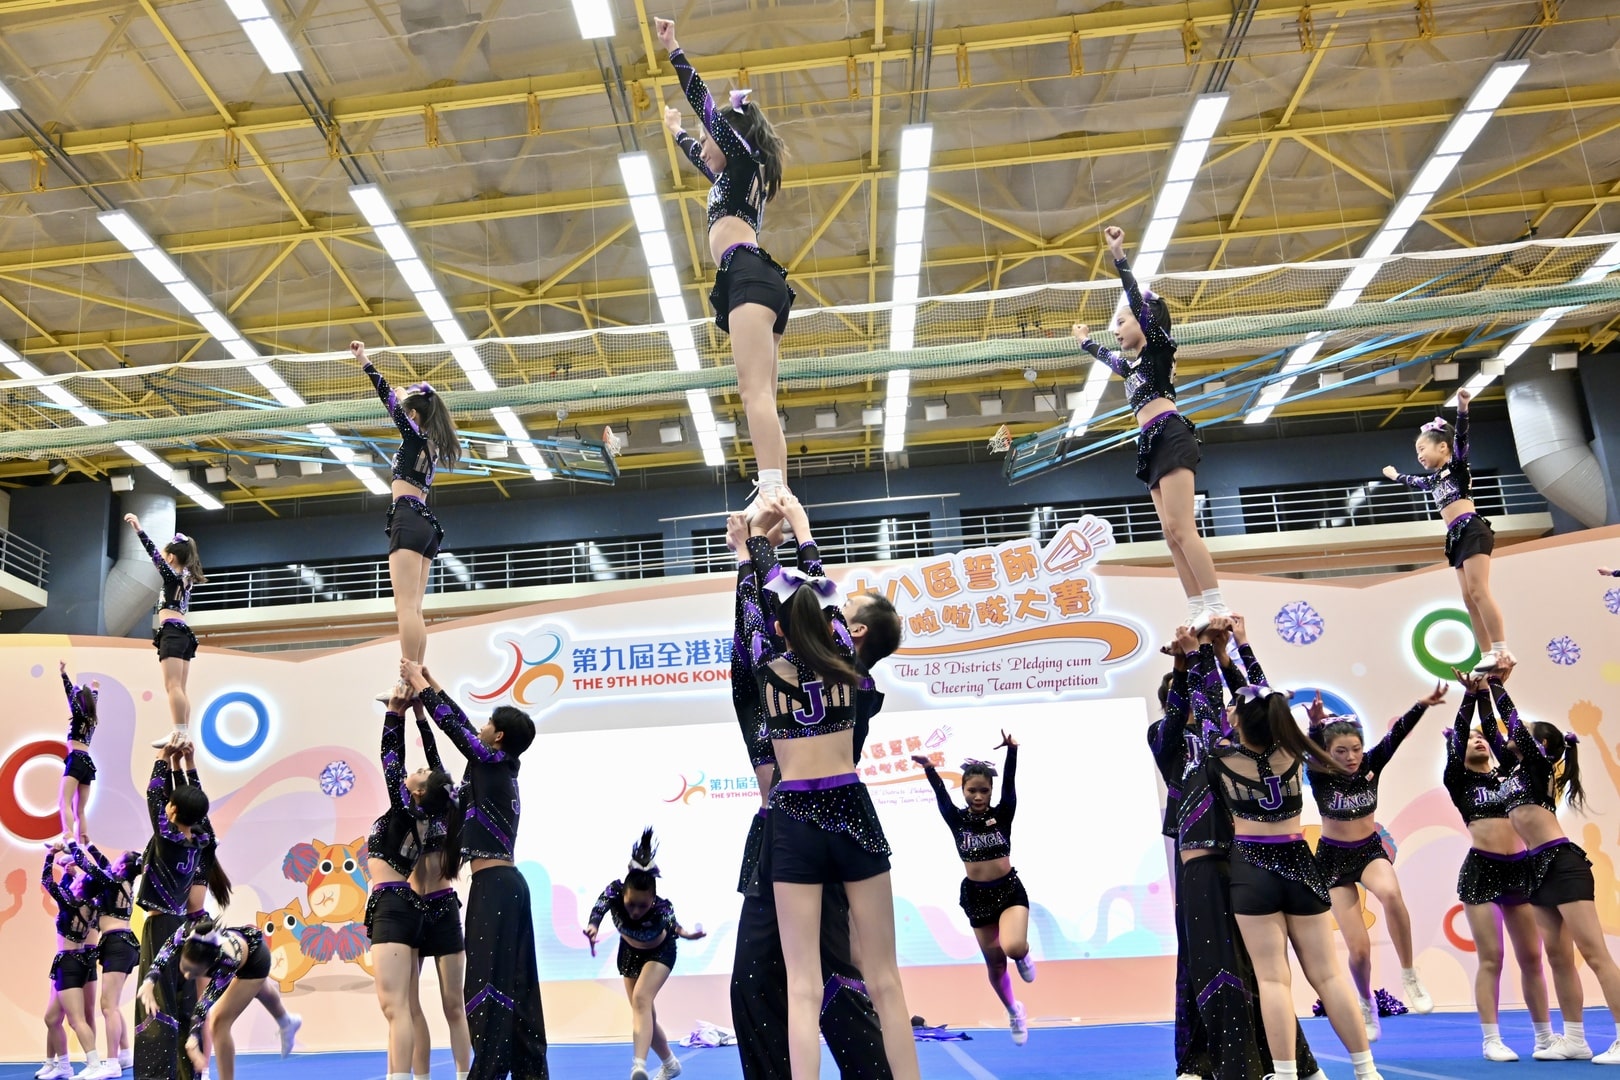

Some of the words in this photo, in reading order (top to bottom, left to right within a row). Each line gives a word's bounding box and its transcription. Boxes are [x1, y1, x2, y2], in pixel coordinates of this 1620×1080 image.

[898, 578, 1094, 636] 啦啦隊大賽
[572, 638, 733, 674] 第九屆全港運
[894, 664, 919, 678] The
[924, 661, 941, 676] 18
[1007, 656, 1063, 673] Pledging
[1066, 657, 1092, 667] cum
[572, 677, 603, 690] THE
[606, 675, 637, 688] 9TH
[641, 671, 689, 686] HONG
[931, 680, 984, 697] Cheering
[987, 677, 1023, 692] Team
[1026, 674, 1099, 692] Competition
[792, 680, 826, 726] J
[1258, 775, 1284, 811] J
[1329, 789, 1376, 810] JENGA
[960, 830, 1007, 851] JENGA
[176, 848, 198, 875] J
